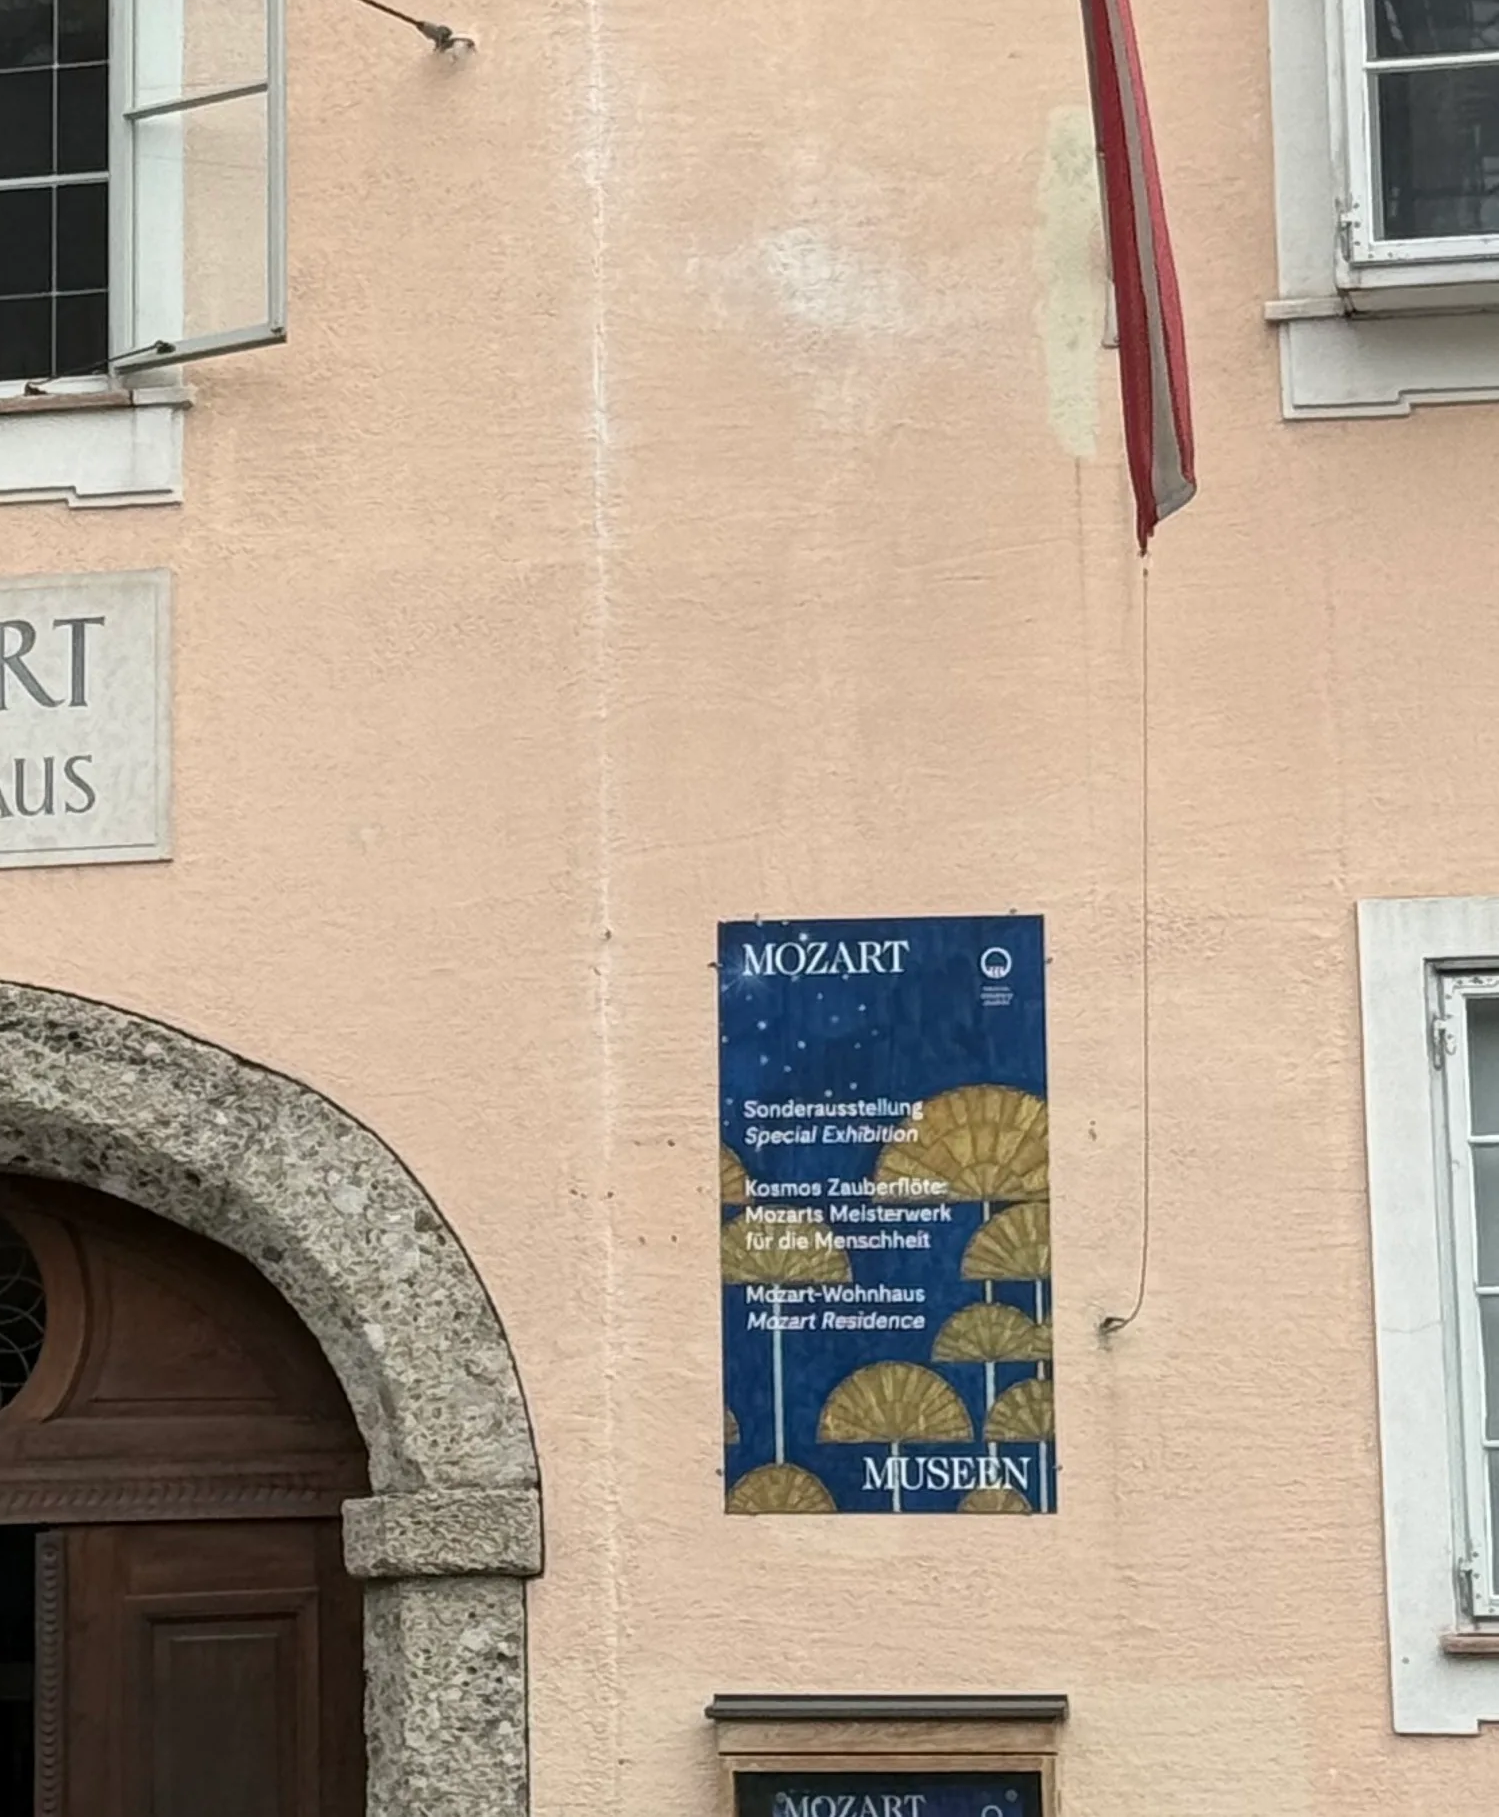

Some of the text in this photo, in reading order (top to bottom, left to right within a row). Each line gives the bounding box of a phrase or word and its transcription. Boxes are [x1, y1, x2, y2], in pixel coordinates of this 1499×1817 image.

[742, 939, 910, 977] MOZART
[744, 1099, 924, 1121] Sonderausstellung
[744, 1124, 919, 1148] Special Exhibition
[745, 1179, 822, 1197] Kosmos
[745, 1204, 951, 1224] Mozarts Meisterwerk
[745, 1230, 931, 1251] für die Menschheit
[745, 1285, 926, 1305] Mozart-Wohnhaus
[746, 1311, 926, 1331] Mozart Residence
[861, 1456, 1032, 1491] MUSEEN
[782, 1794, 927, 1817] MOZART
